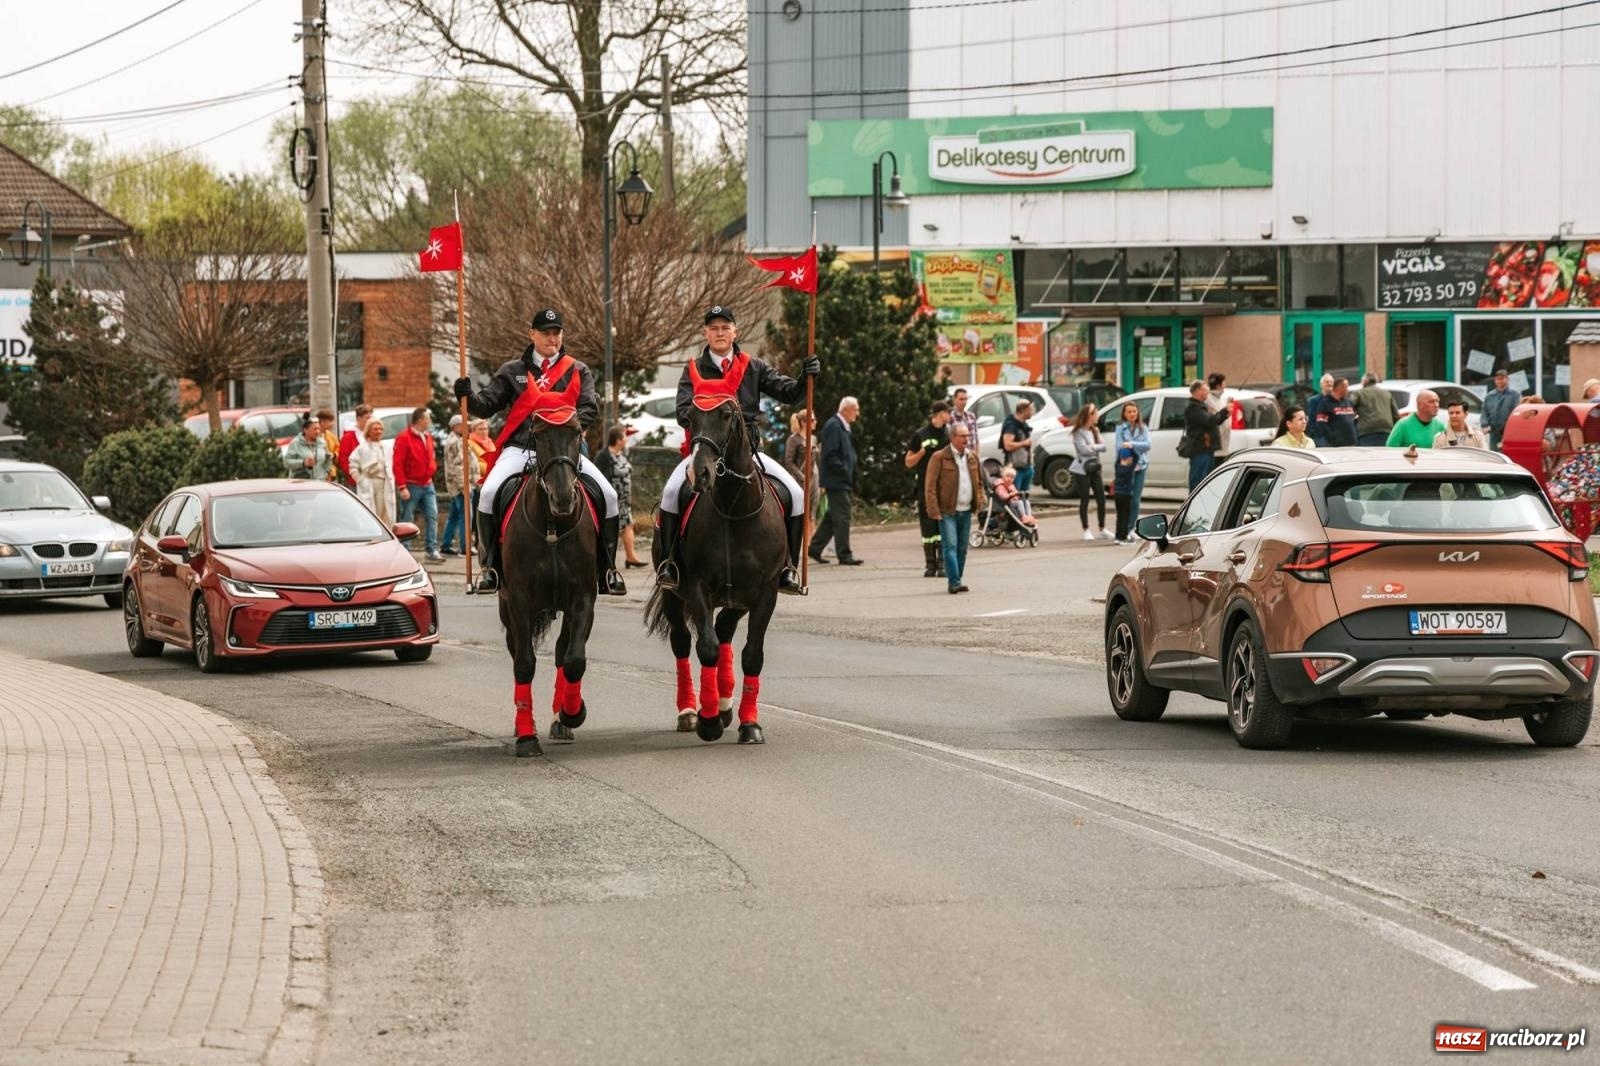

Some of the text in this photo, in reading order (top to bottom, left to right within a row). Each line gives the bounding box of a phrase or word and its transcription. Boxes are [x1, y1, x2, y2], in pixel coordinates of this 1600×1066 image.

[937, 145, 1125, 171] Delikatesy Centrum
[1395, 247, 1431, 258] Pizzeria
[1382, 255, 1446, 274] VEGAS
[1382, 290, 1401, 306] 32
[1404, 286, 1433, 303] 793
[1436, 283, 1455, 300] 50
[1457, 281, 1477, 297] 79
[317, 610, 373, 625] SRC TM49
[1419, 613, 1504, 629] WOT 90587
